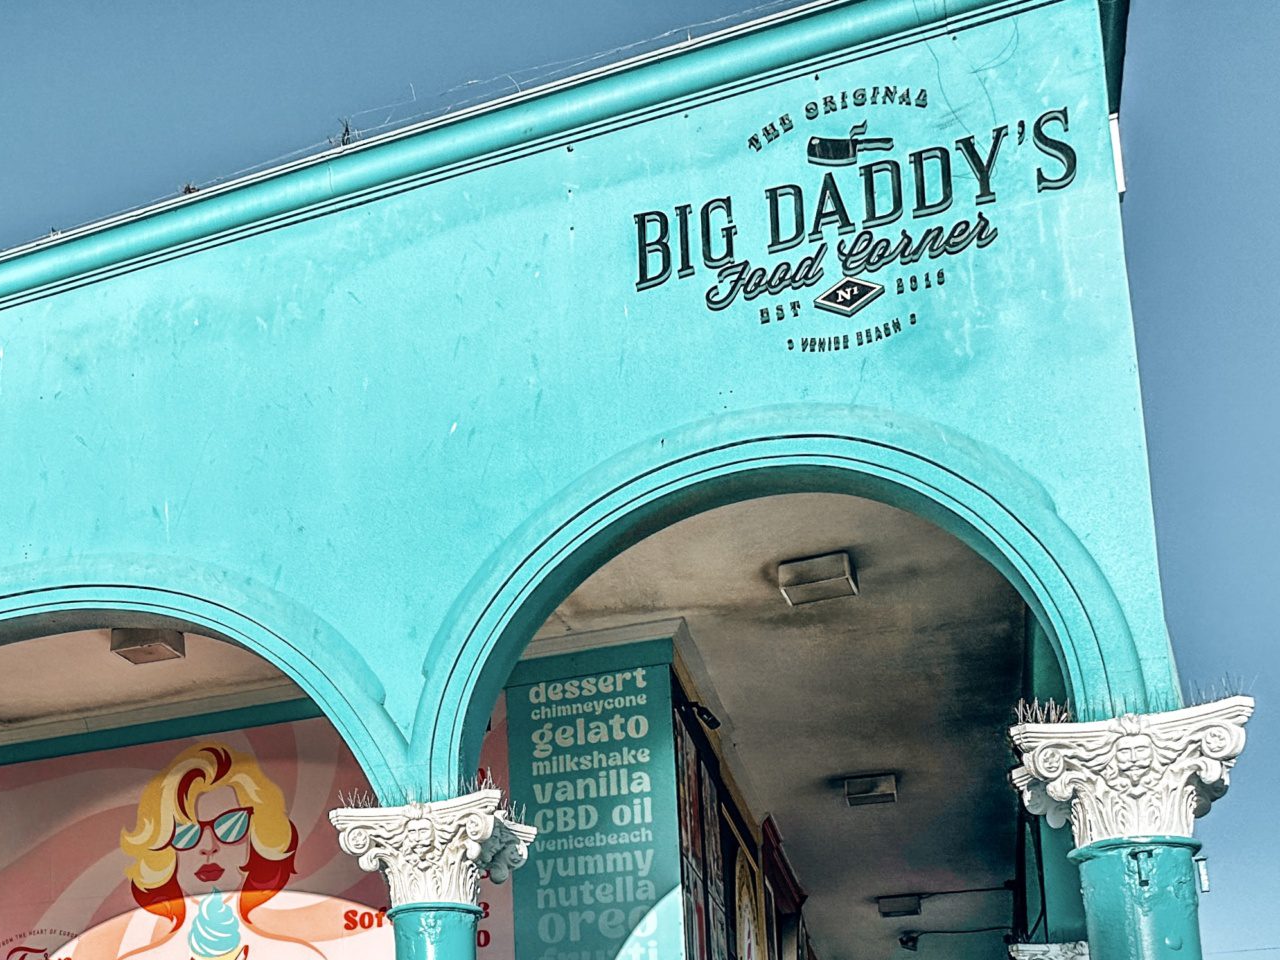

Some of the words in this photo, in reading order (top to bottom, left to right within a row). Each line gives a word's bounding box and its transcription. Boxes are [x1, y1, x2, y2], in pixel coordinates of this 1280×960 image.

[748, 113, 794, 152] THE
[804, 85, 928, 121] ORIGINAL
[632, 196, 738, 293] BIG
[764, 106, 1077, 254] DADDY'S
[705, 242, 828, 311] Food
[837, 211, 998, 277] Corner
[759, 301, 801, 325] EST
[800, 335, 849, 352] VENICE
[855, 317, 903, 347] BEACH
[528, 667, 647, 704] dessert
[531, 693, 647, 720] chimneycone
[531, 714, 649, 759] gelato
[532, 747, 651, 776] milkshake
[533, 768, 652, 804] vanilla
[534, 804, 598, 834] CBD
[612, 797, 653, 826] oil
[535, 827, 653, 852] venicebeach
[536, 849, 655, 886] yummy
[536, 876, 656, 909] nutella
[15, 932, 27, 940] THE
[28, 928, 47, 936] HEART
[343, 906, 394, 931] Sof
[538, 905, 658, 944] oreo
